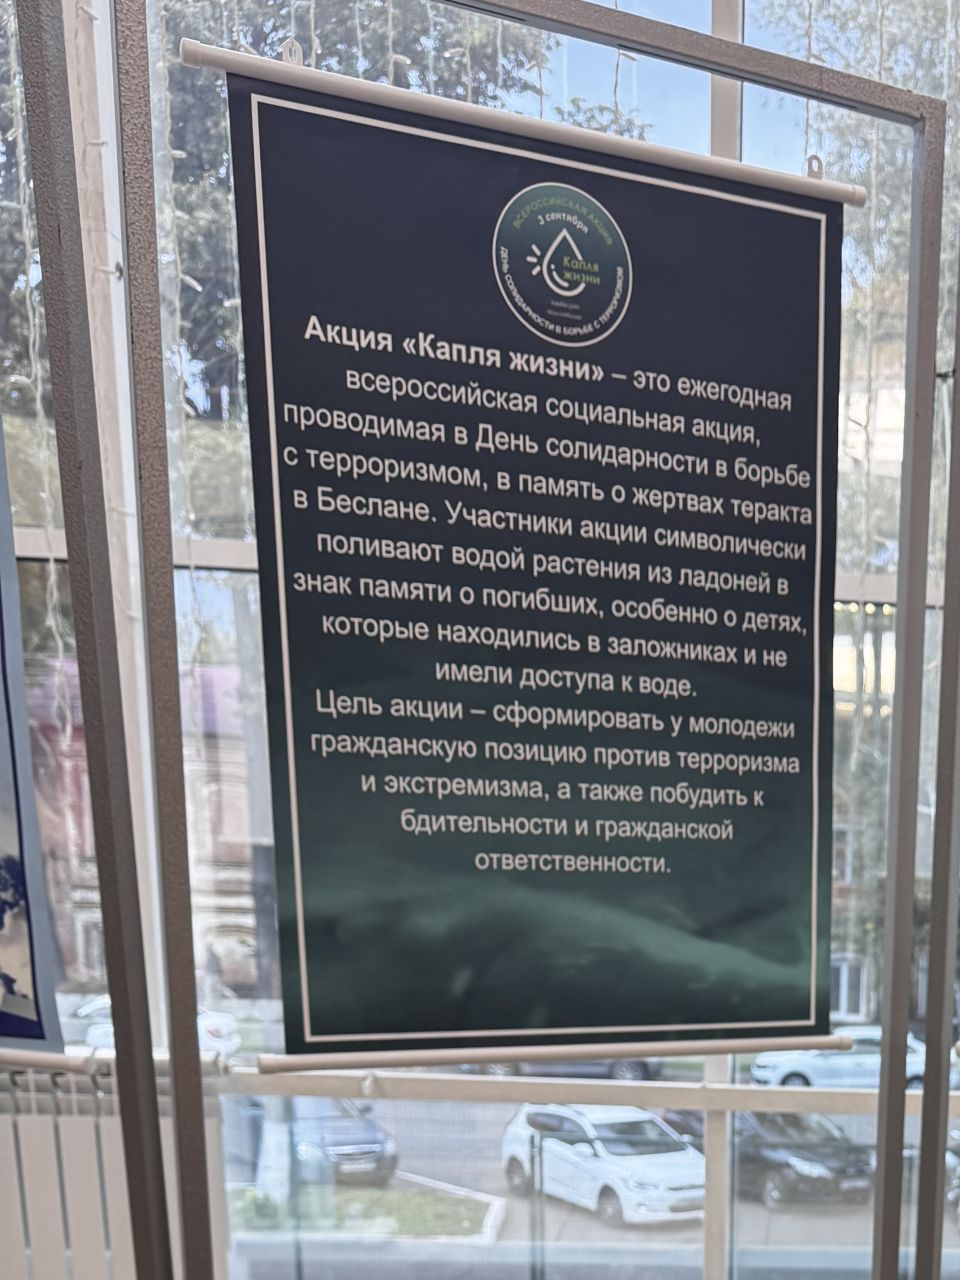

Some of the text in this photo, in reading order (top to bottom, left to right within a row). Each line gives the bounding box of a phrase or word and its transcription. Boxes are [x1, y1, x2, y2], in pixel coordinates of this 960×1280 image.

[537, 212, 589, 235] 3 сентября
[499, 246, 509, 274] ДЕНЬ
[504, 273, 555, 332] СОЛИДАРНОСТИ
[562, 255, 600, 274] Капля
[562, 271, 601, 286] жизни
[303, 314, 393, 353] Акция
[402, 331, 502, 369] «Капля
[508, 351, 605, 382] жизни»
[633, 369, 671, 393] это
[677, 376, 792, 412] ежегодная
[345, 369, 761, 448] всероссийская социальная акция,
[283, 403, 811, 489] проводимая в День солидарности в борьбе
[283, 446, 813, 525] с терроризмом, в память о жертвах теракта
[293, 485, 806, 561] в Беслане. Участники акции символически
[316, 532, 789, 596] поливают водой растения из ладоней в
[293, 571, 807, 637] знак памяти о погибших, особенно о детях,
[322, 614, 788, 668] которые находились в заложниках и не
[435, 661, 697, 700] имели доступа к воде.
[315, 688, 383, 720] Цель
[389, 698, 464, 723] акции
[492, 699, 665, 733] сформировать
[670, 715, 683, 738] у
[689, 715, 795, 740] молодежи
[310, 733, 800, 776] гражданскую позицию против терроризма
[360, 774, 764, 810] и экстремизма, а также побудить к
[400, 808, 734, 842] бдительности и гражданской
[474, 852, 671, 873] ответственности.
